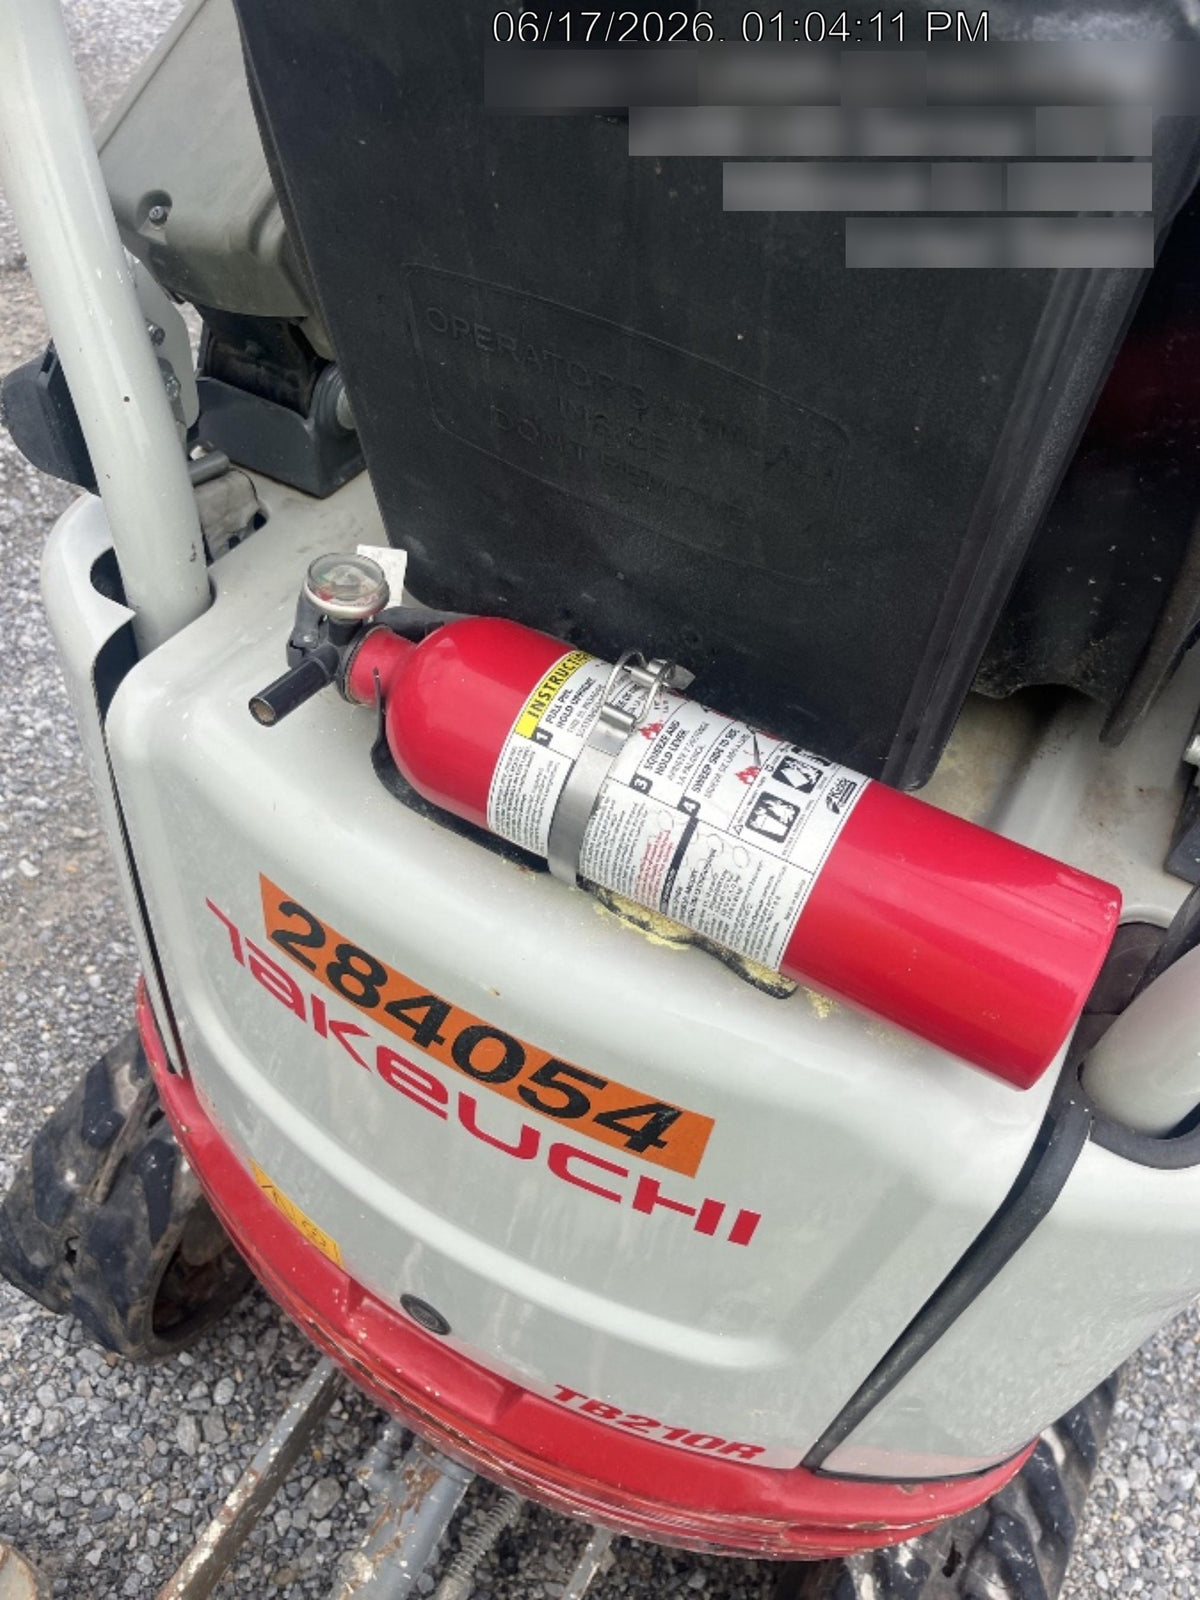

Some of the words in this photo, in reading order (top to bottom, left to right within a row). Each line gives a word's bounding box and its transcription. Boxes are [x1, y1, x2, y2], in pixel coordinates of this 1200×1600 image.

[535, 730, 549, 741] 1
[633, 777, 648, 790] 3
[681, 800, 696, 812] 4
[271, 901, 680, 1153] 284054
[554, 1384, 767, 1460] TB210R
